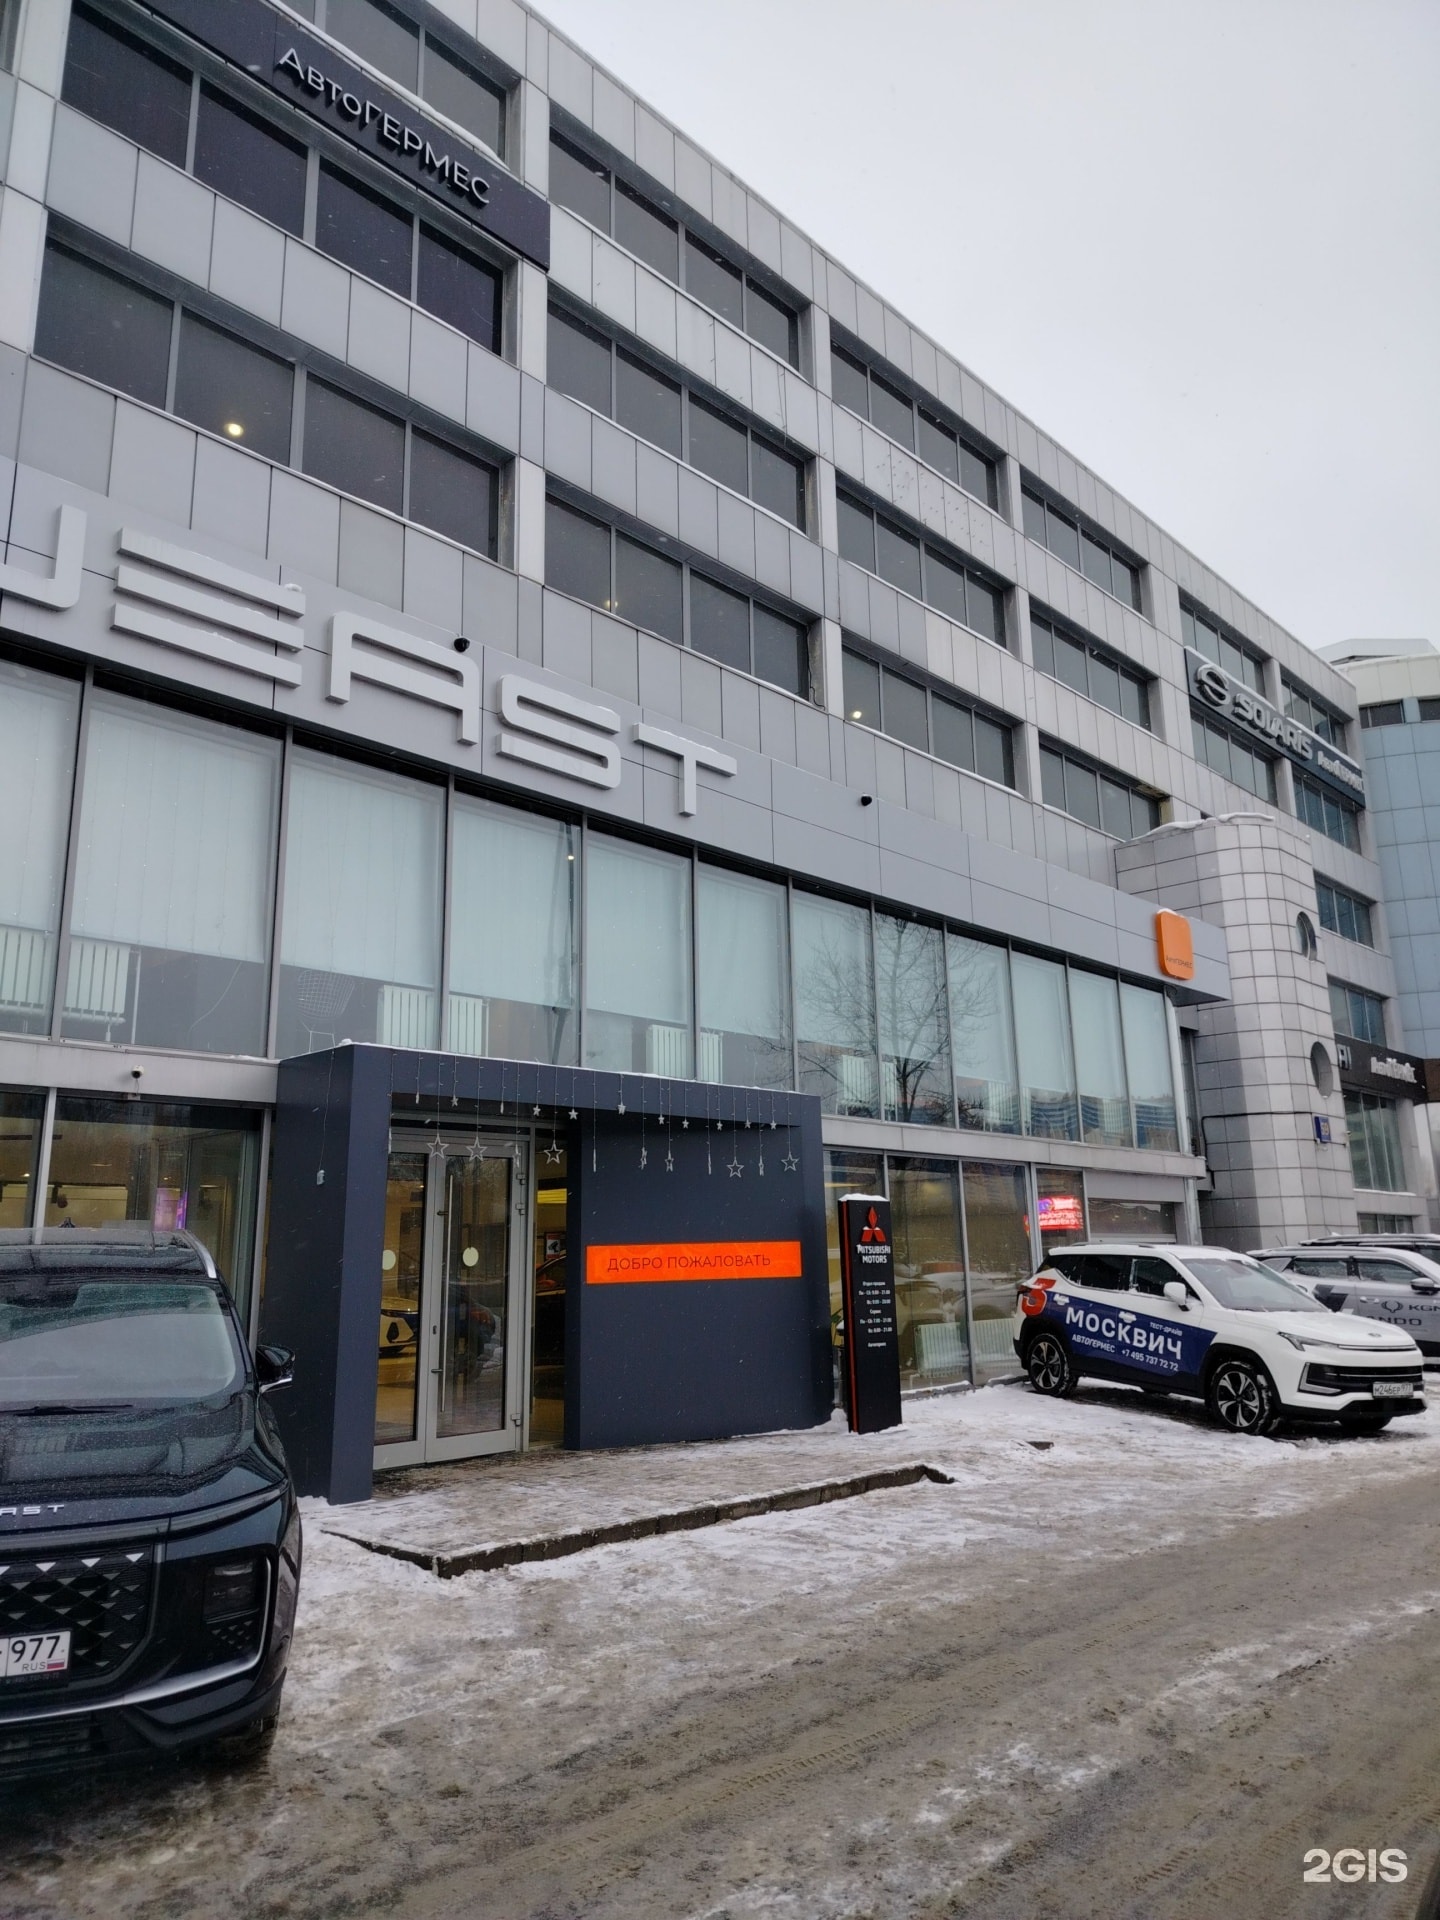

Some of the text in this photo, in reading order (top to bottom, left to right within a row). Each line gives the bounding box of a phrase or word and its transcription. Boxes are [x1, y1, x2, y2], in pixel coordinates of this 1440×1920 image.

[856, 1244, 891, 1254] MITSUBISHI
[607, 1254, 771, 1272] ДОБРО ПОЖАЛОВАТЬ
[862, 1255, 887, 1264] MOTORS
[1065, 1307, 1182, 1360] МОСКВИЧ
[1150, 1321, 1182, 1336] ТЕСТ-ДРАЙВ
[1071, 1334, 1115, 1353] АВТОГЕРМЕС
[1121, 1349, 1179, 1371] +7 495 737 72 72
[11, 1635, 61, 1663] 977
[22, 1661, 46, 1671] RUS
